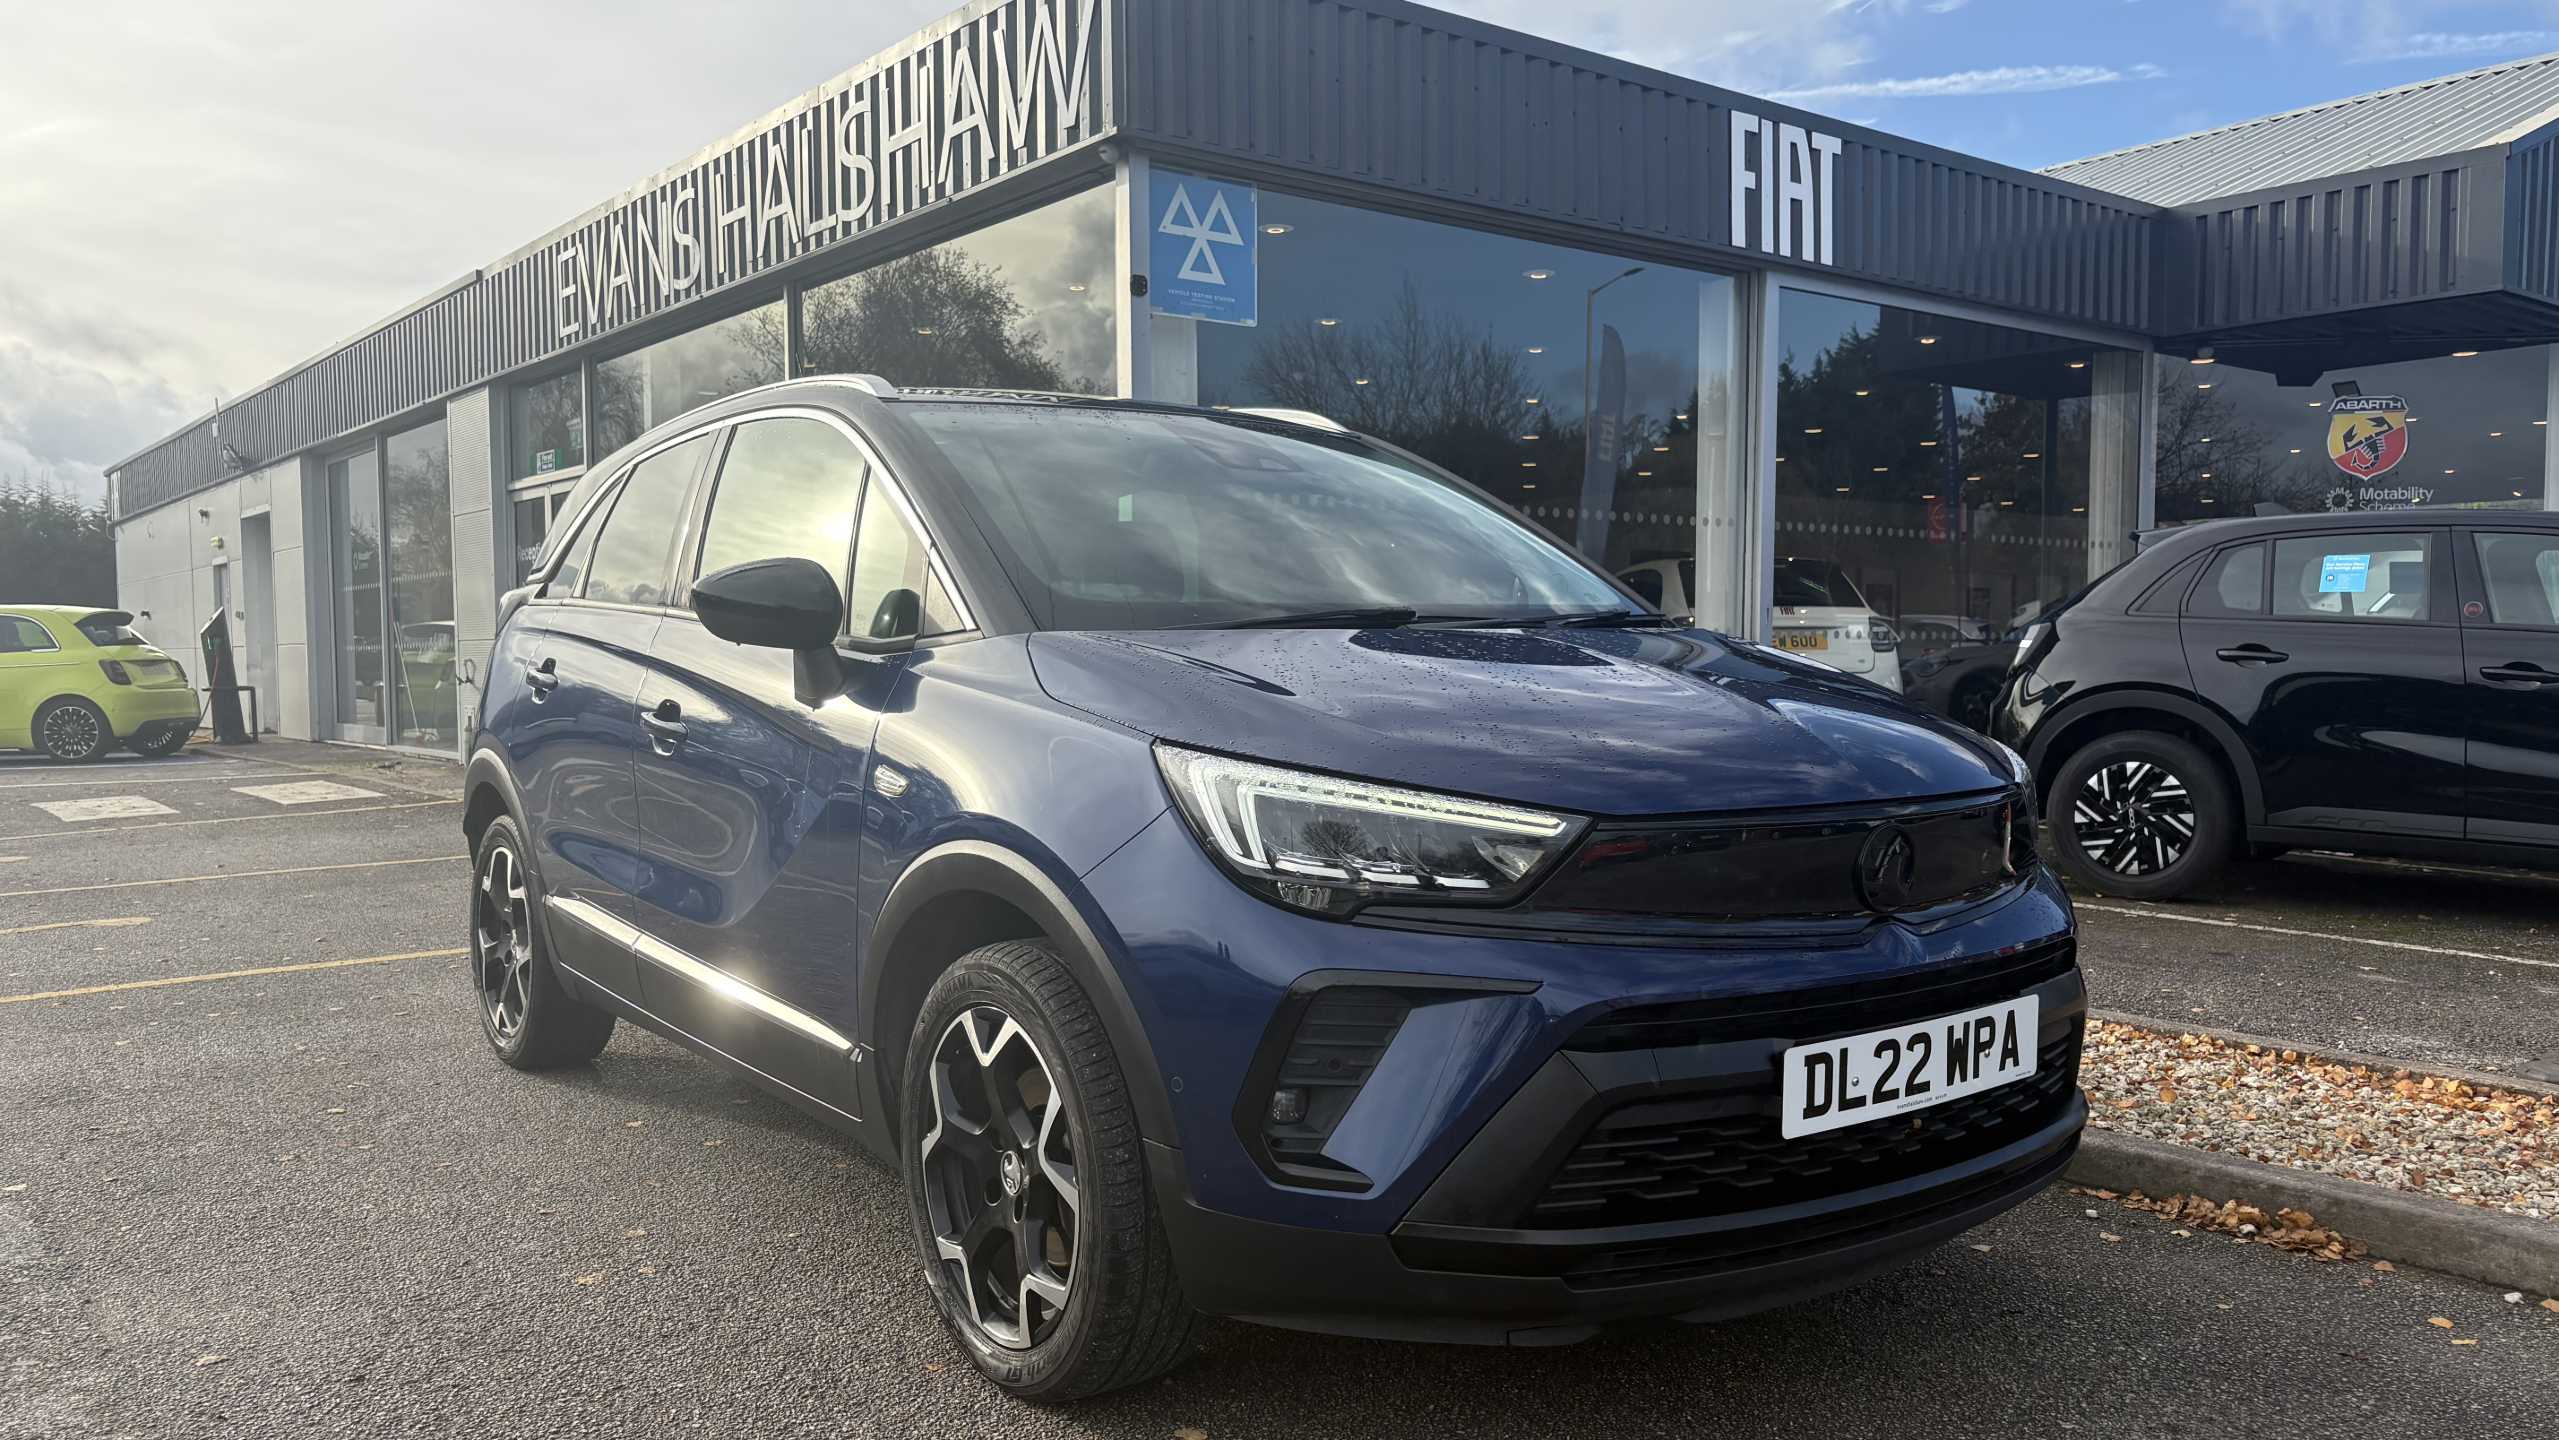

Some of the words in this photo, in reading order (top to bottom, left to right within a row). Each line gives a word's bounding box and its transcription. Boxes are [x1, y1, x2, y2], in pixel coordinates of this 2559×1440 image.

[556, 188, 701, 338] EVANS
[715, 0, 1098, 275] HALSHAW
[1730, 109, 1842, 266] FIAT
[2335, 399, 2402, 410] ABARTH
[2359, 485, 2434, 502] Motability
[2359, 500, 2416, 512] Scheme
[1802, 1031, 1934, 1121] DL22
[1946, 1009, 2020, 1087] WPA
